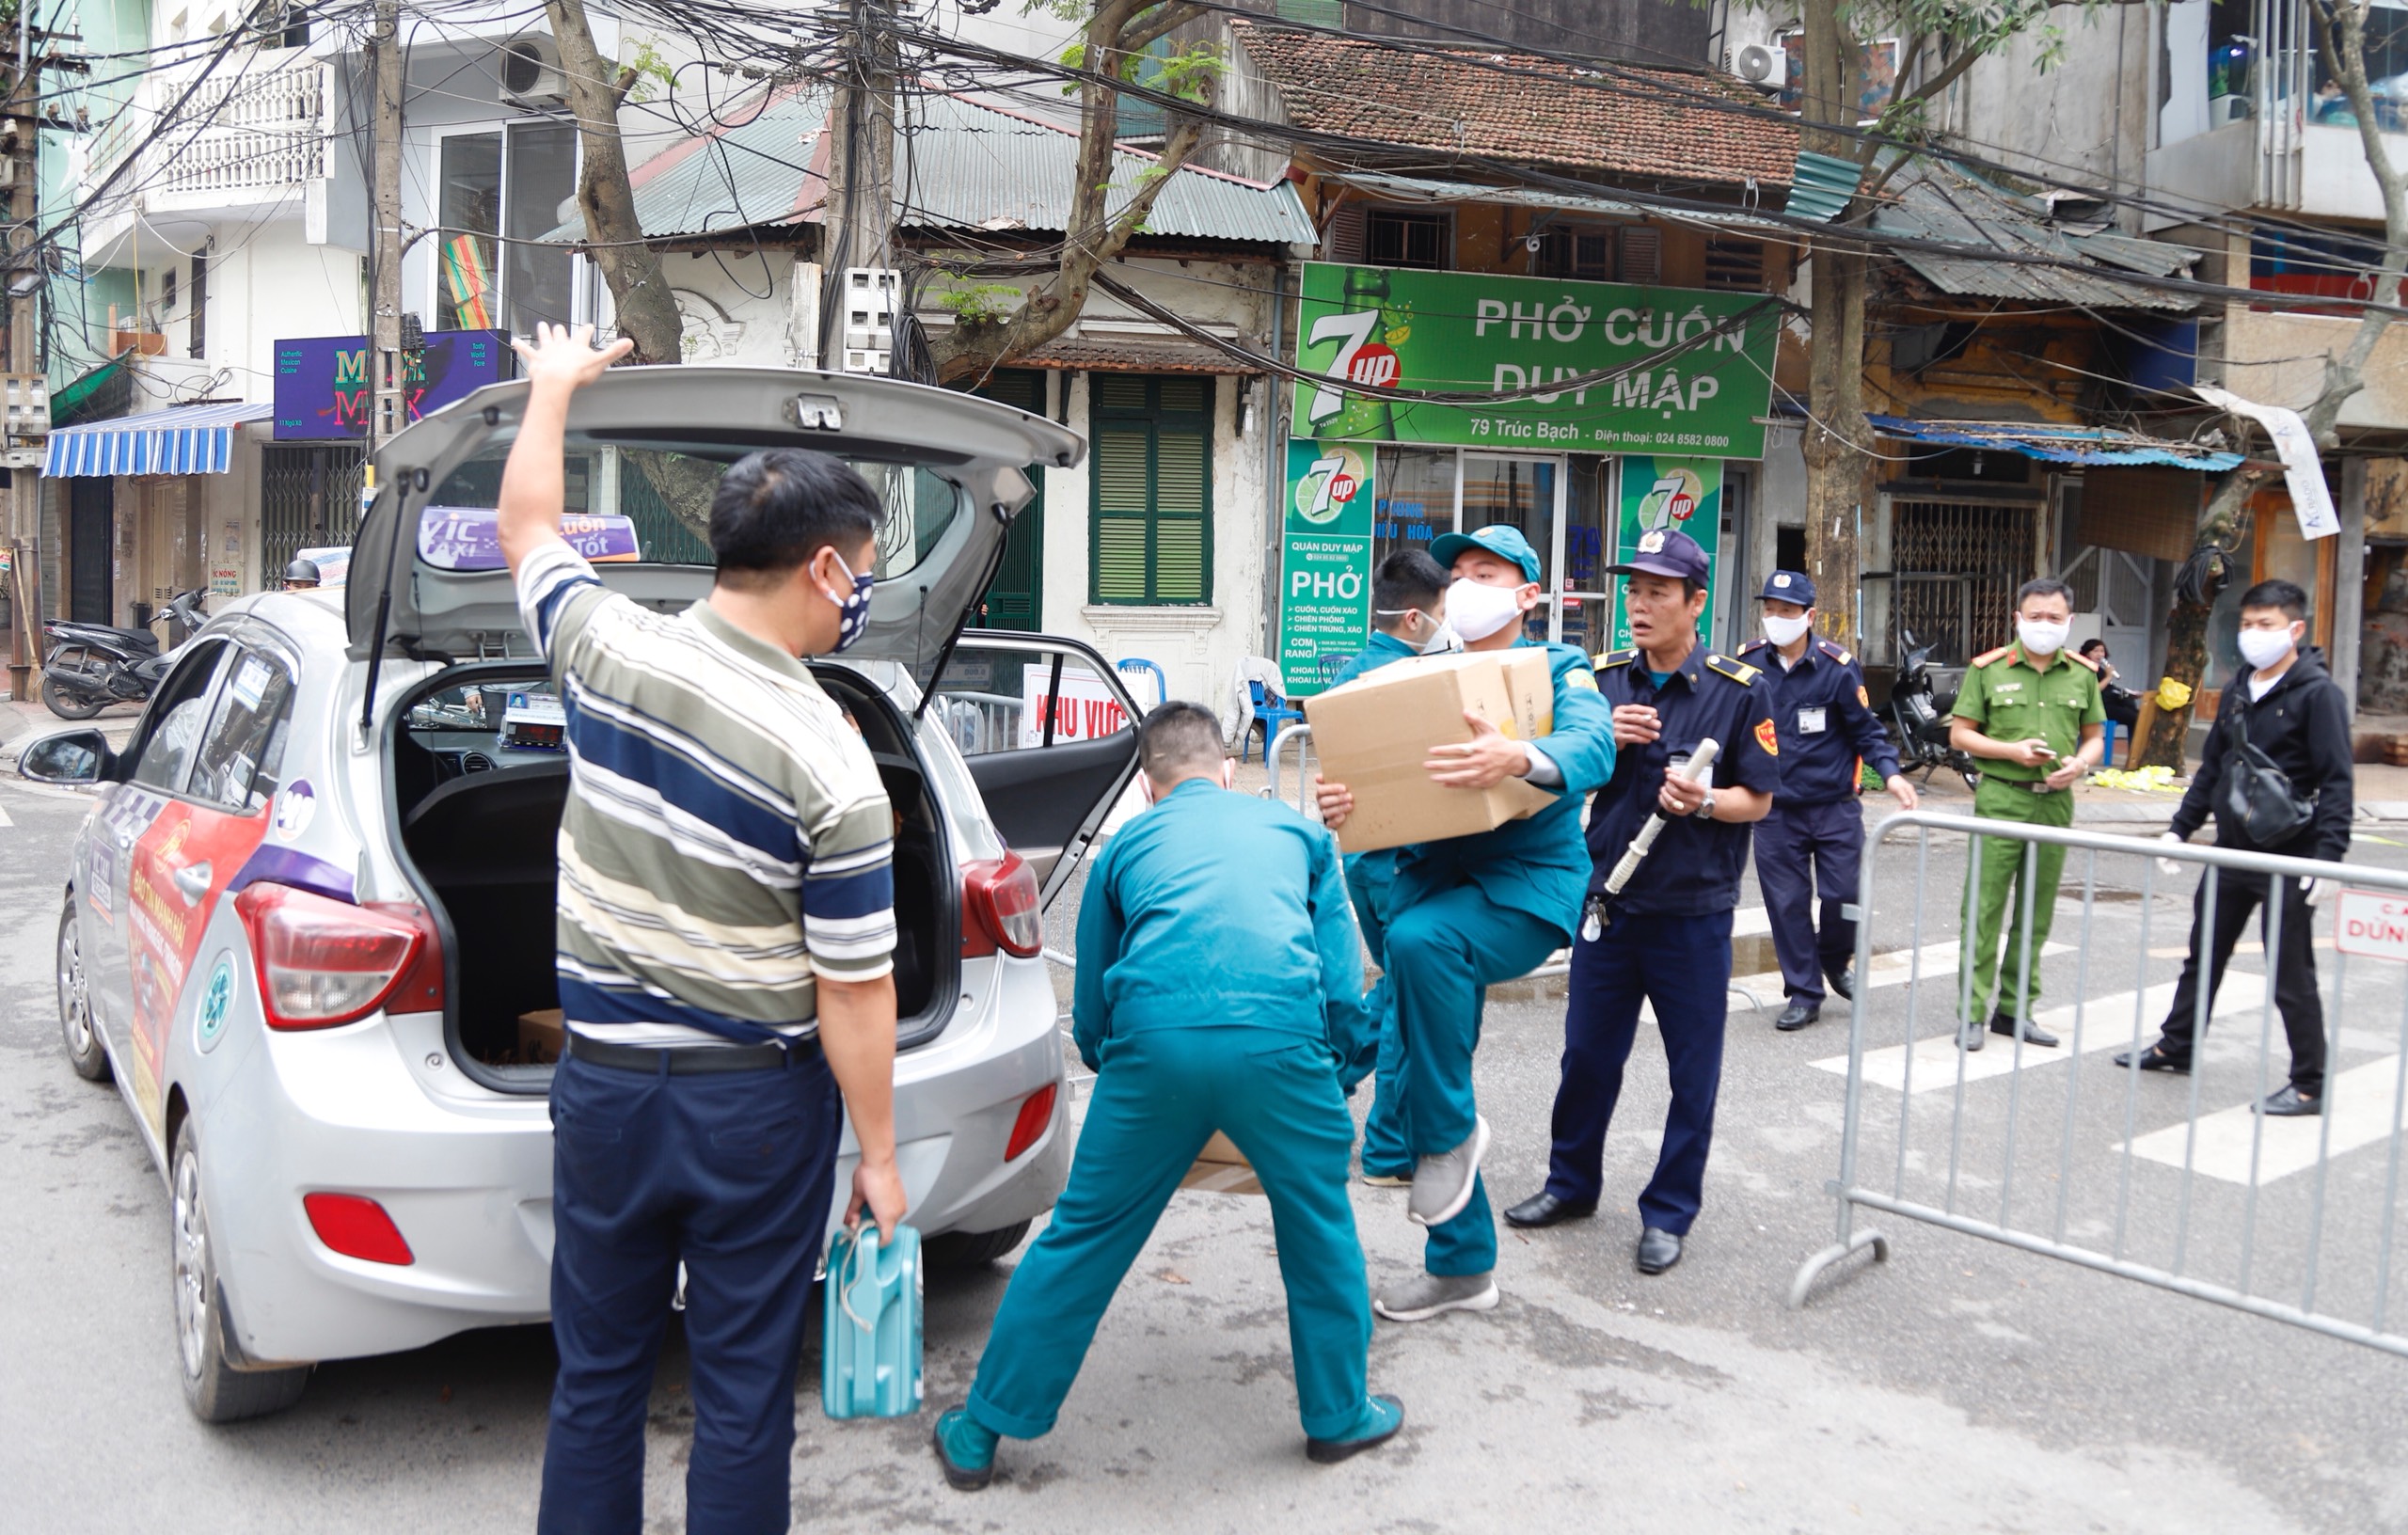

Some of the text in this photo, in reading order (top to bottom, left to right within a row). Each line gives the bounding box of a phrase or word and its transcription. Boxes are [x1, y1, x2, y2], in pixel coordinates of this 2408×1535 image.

[1475, 294, 1748, 353] PHỞ CUỐN
[1493, 363, 1719, 419] DUY MẬP
[1470, 419, 1490, 436] 79
[1496, 419, 1532, 438] Trúc
[1537, 421, 1579, 442] Bạch
[1594, 429, 1620, 444] Điện
[1622, 431, 1653, 445] thoại:
[1656, 433, 1675, 445] 024
[1677, 434, 1702, 446] 8582
[1704, 435, 1729, 448] 0800
[1291, 541, 1364, 555] QUÁN DUY MẬP
[1291, 564, 1363, 599] PHỞ
[1285, 649, 1312, 658] RANG
[1291, 666, 1315, 674] KHOAI
